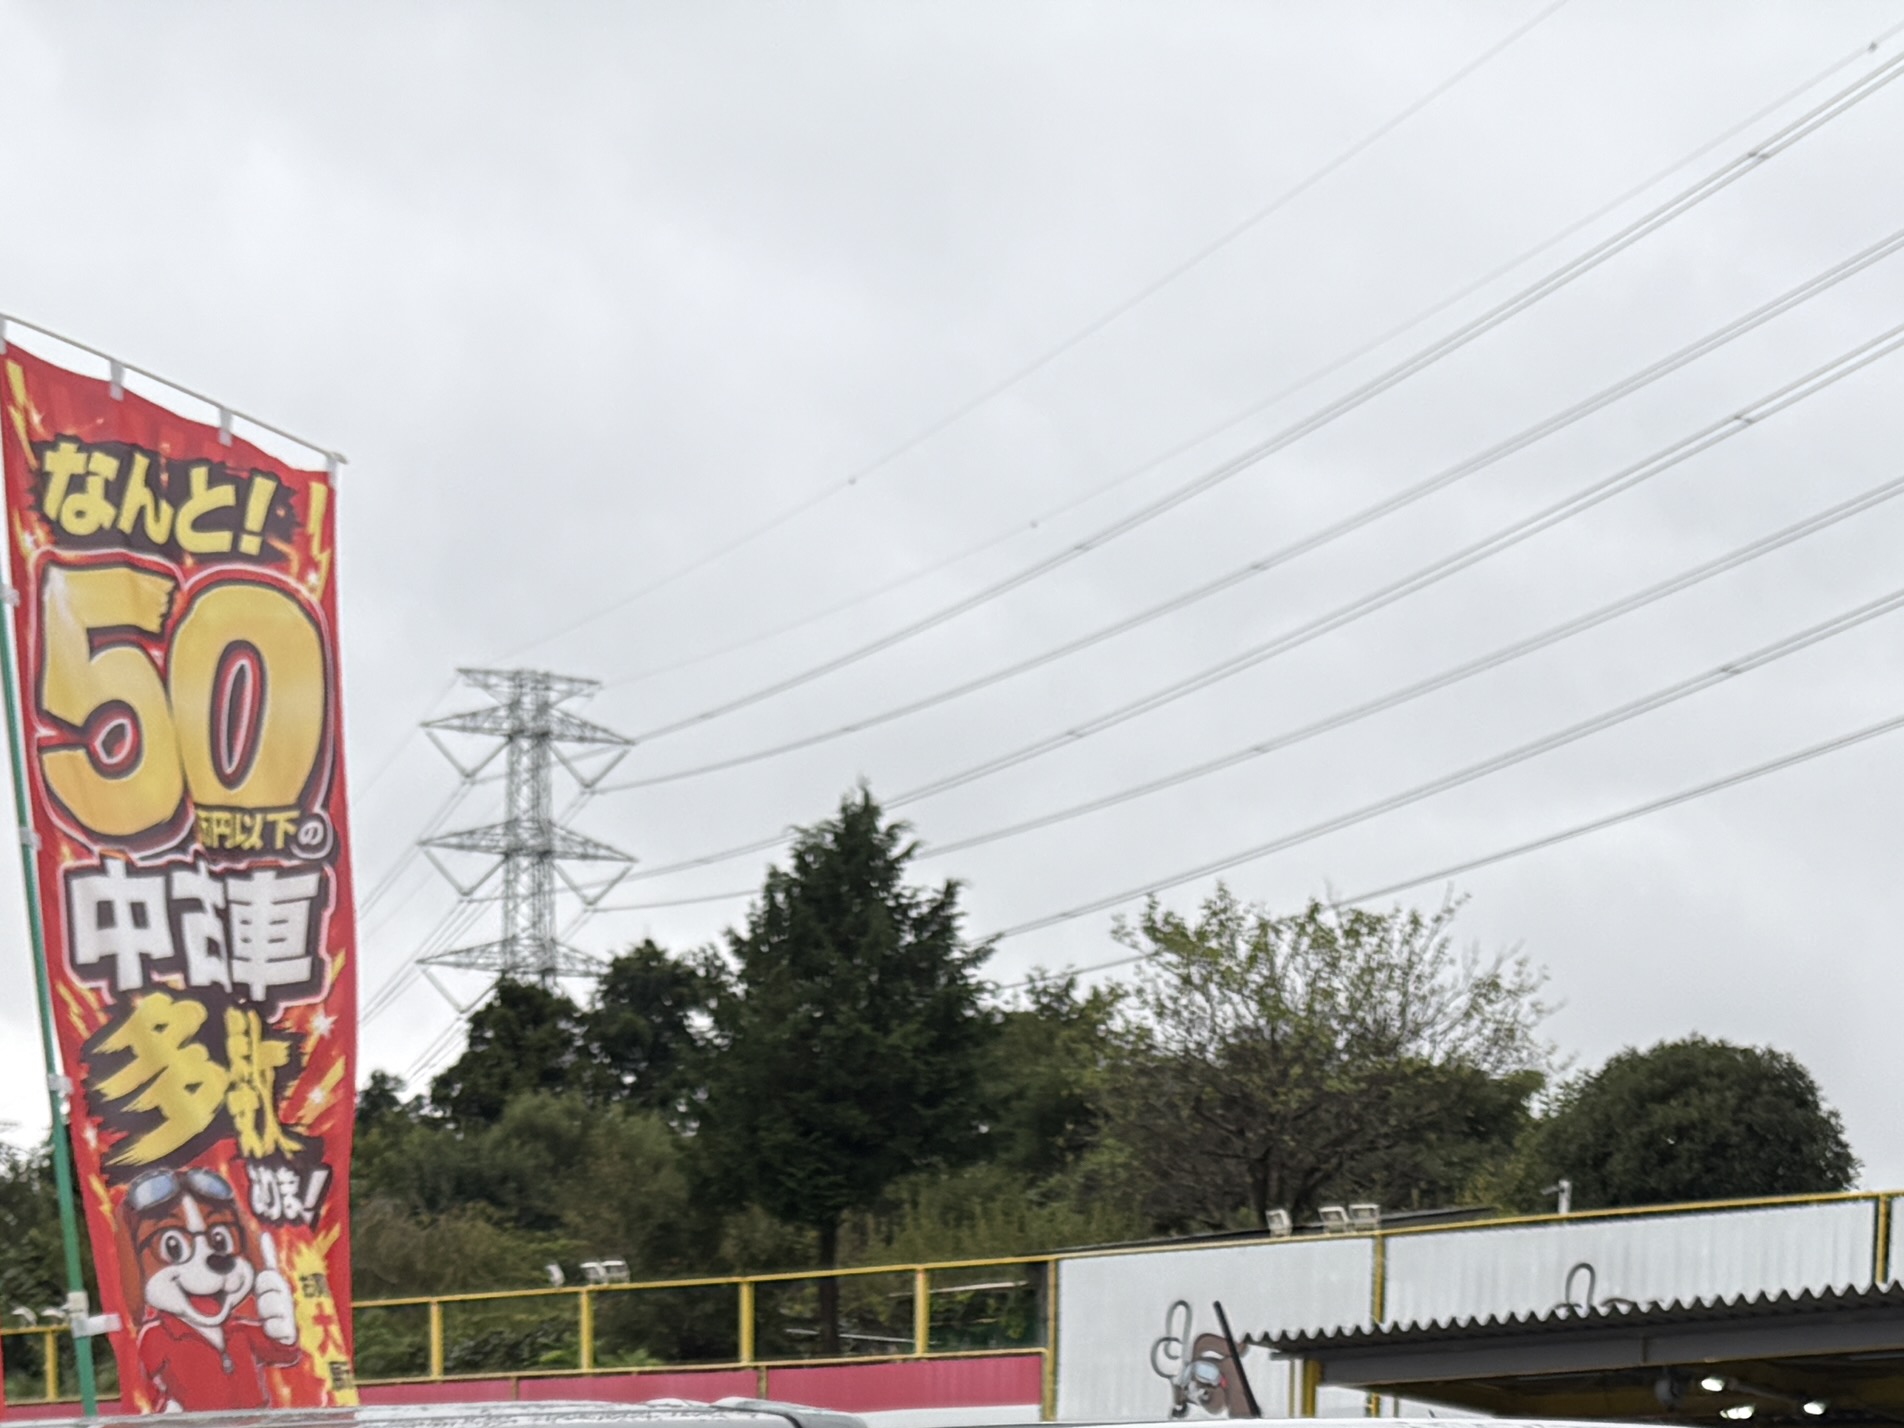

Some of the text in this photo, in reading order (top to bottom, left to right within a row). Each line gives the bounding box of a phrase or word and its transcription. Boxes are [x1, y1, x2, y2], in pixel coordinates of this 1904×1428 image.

[42, 441, 277, 556] なんと!
[39, 565, 325, 836] 50
